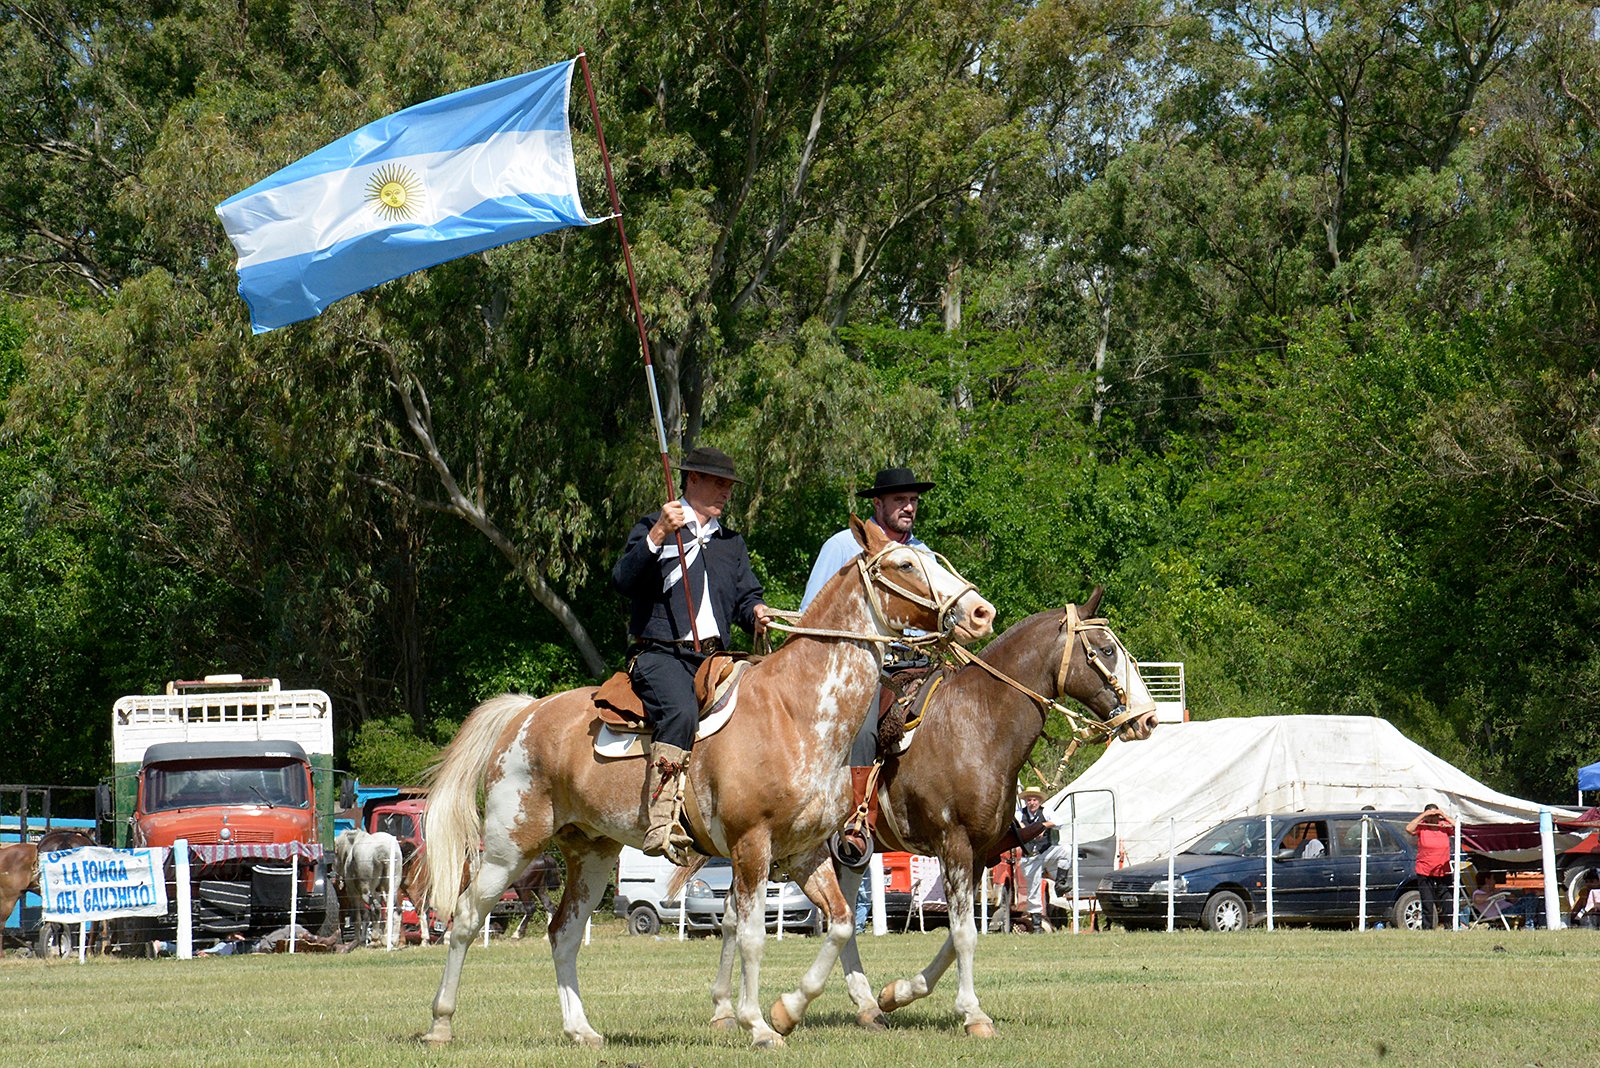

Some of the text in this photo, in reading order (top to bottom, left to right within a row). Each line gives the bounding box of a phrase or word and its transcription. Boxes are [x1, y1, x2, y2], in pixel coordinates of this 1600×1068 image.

[62, 862, 81, 885] LA
[57, 885, 150, 914] DEL GAUCHITO
